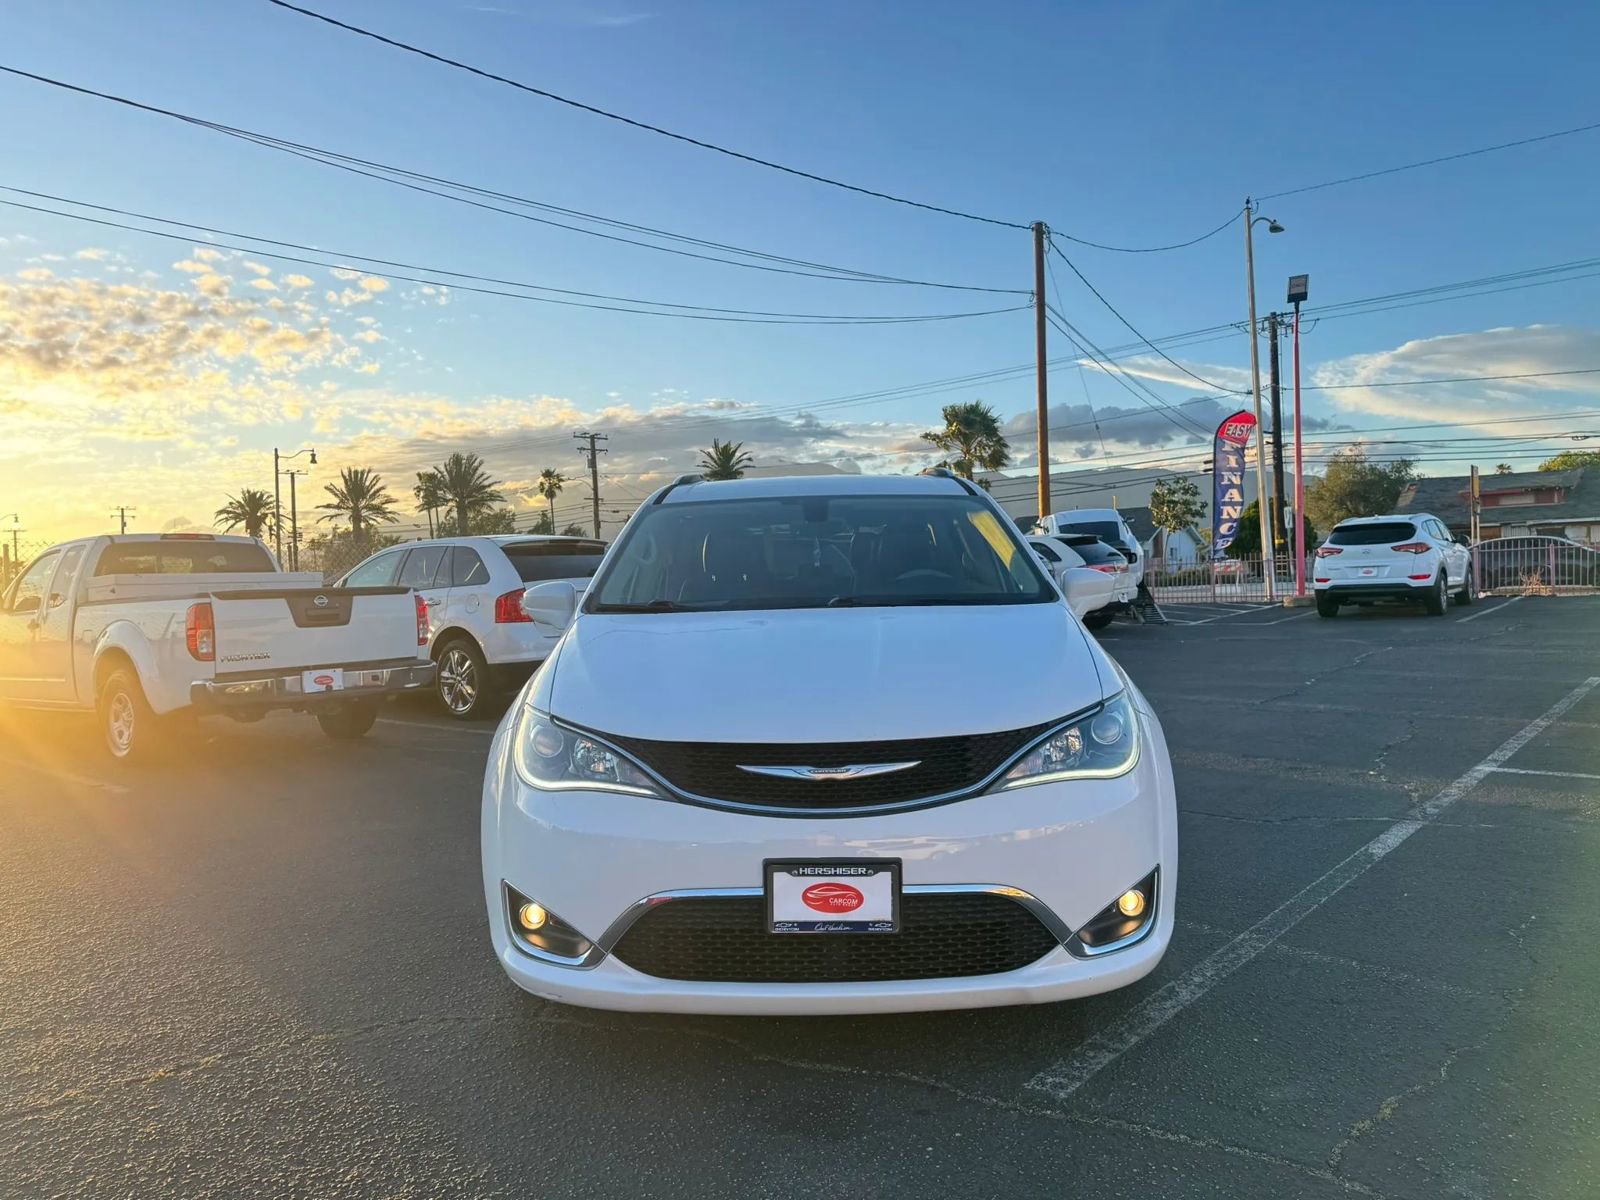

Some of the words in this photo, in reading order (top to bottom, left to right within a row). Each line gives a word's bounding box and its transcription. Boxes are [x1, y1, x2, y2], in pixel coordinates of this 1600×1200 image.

[1225, 423, 1253, 438] EASY
[1214, 440, 1243, 550] FINANCE
[799, 867, 867, 875] HERSHISER
[829, 897, 858, 905] CARCOM
